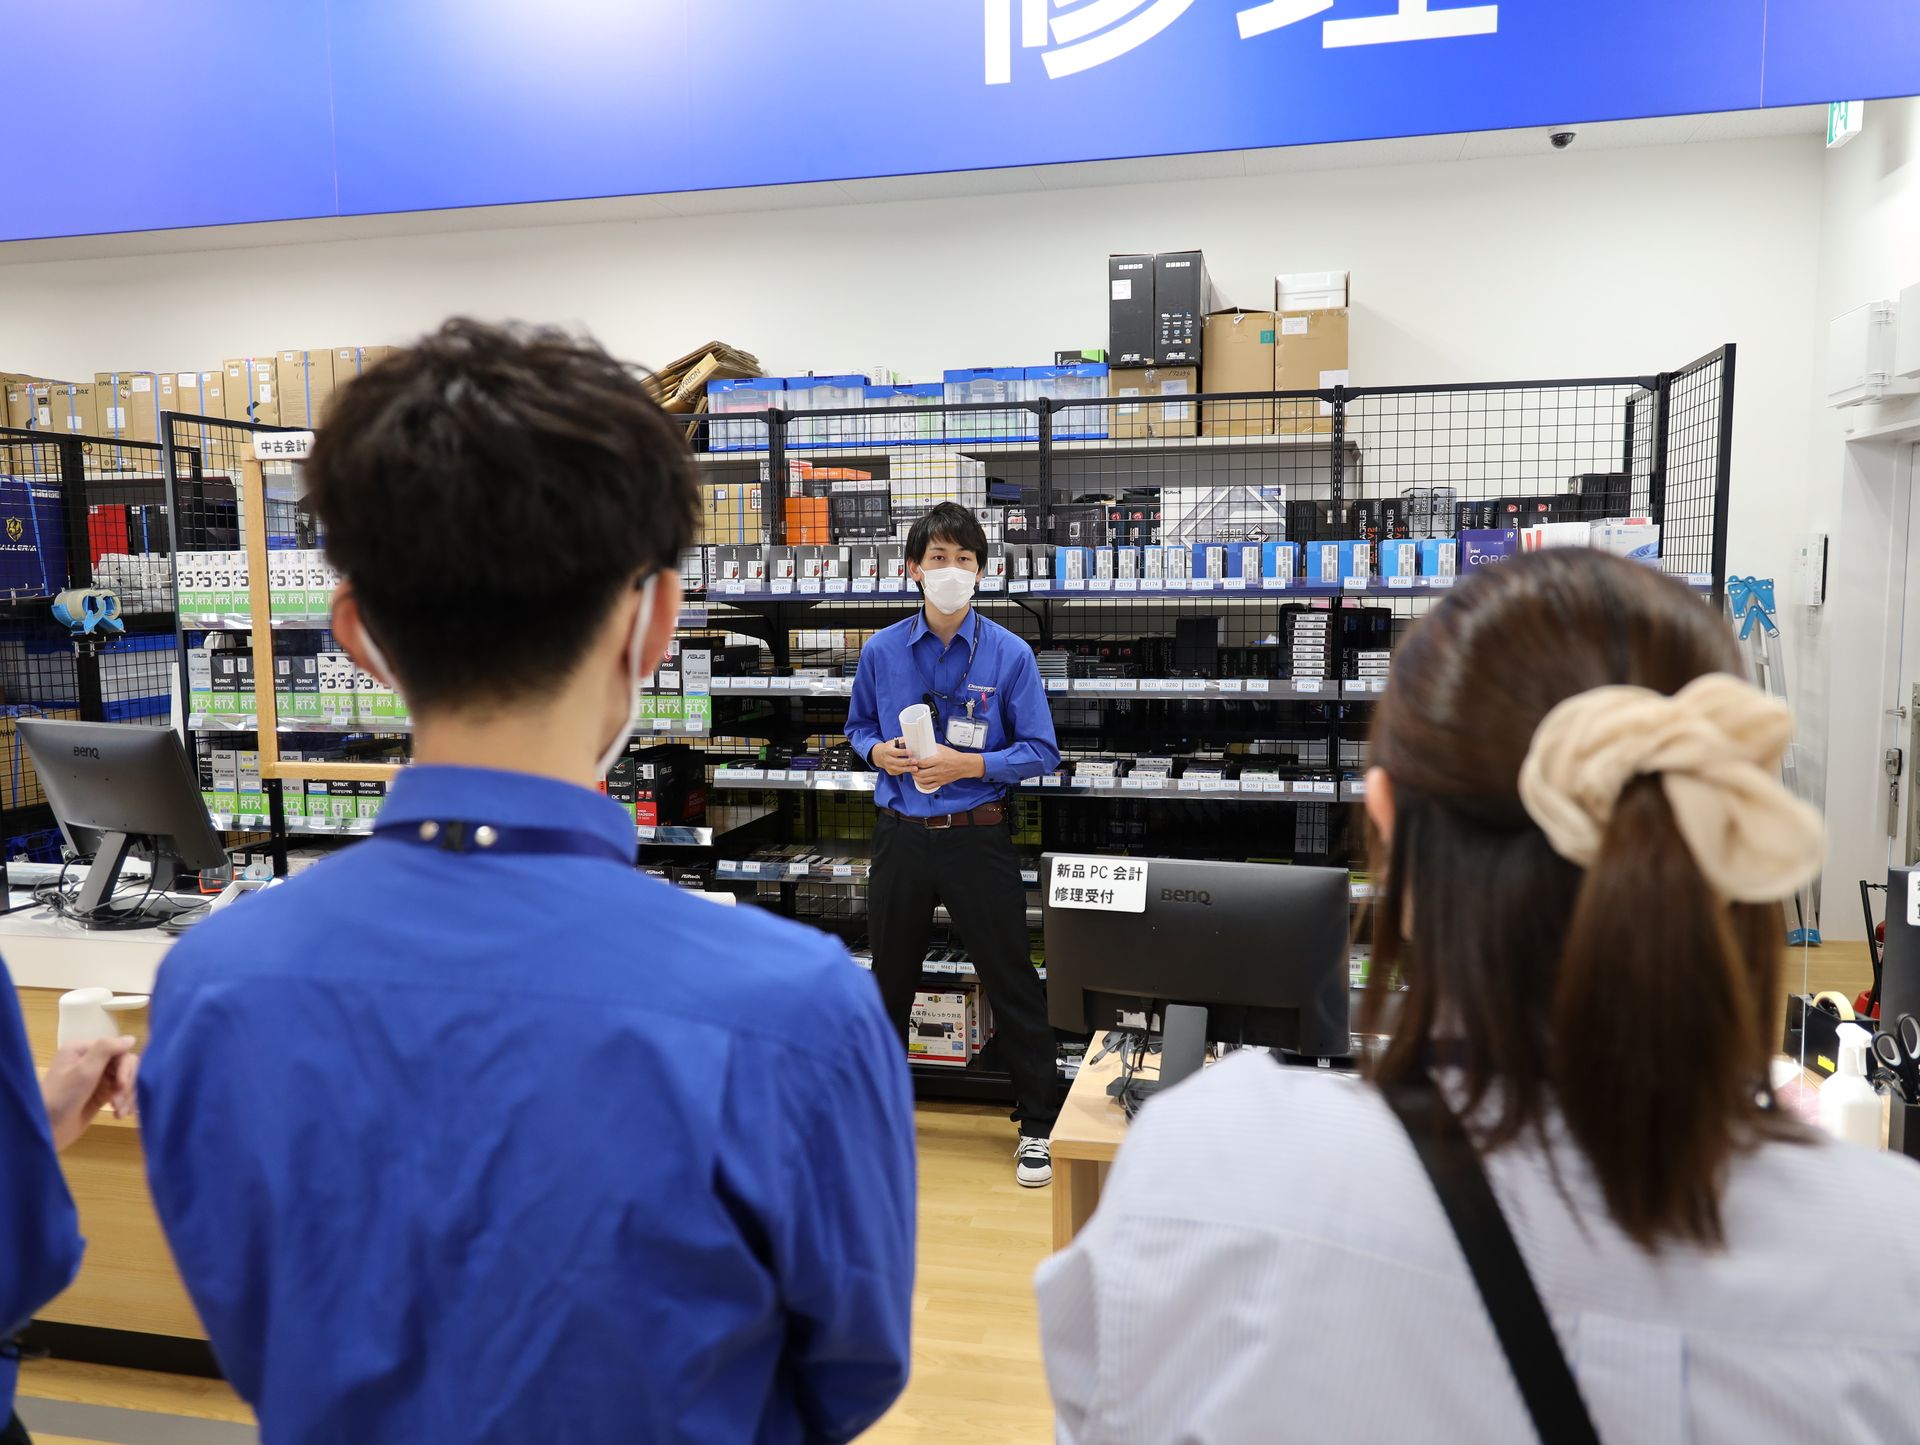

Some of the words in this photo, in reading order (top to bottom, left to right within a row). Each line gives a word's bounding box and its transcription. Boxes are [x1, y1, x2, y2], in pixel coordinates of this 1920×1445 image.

[261, 439, 308, 454] 中古会計
[1507, 531, 1515, 539] i9
[197, 597, 212, 605] RTX
[215, 597, 231, 605] RTX
[289, 596, 304, 604] RTX
[309, 596, 324, 604] RTX
[192, 700, 211, 708] RTX
[214, 700, 235, 709] RTX
[241, 700, 256, 709] RT
[276, 701, 289, 709] TX
[296, 701, 317, 709] RTX
[640, 704, 654, 713] TX
[657, 704, 680, 713] RTX
[685, 704, 708, 713] RTX
[215, 800, 235, 808] RTX
[242, 800, 261, 809] RTX
[309, 802, 329, 811] RTX
[339, 804, 352, 813] TX
[1057, 863, 1085, 879] 新品
[1090, 866, 1108, 879] PC
[1113, 866, 1143, 881] 会計
[1055, 887, 1114, 904] 修理受付
[1161, 888, 1213, 905] BenQ
